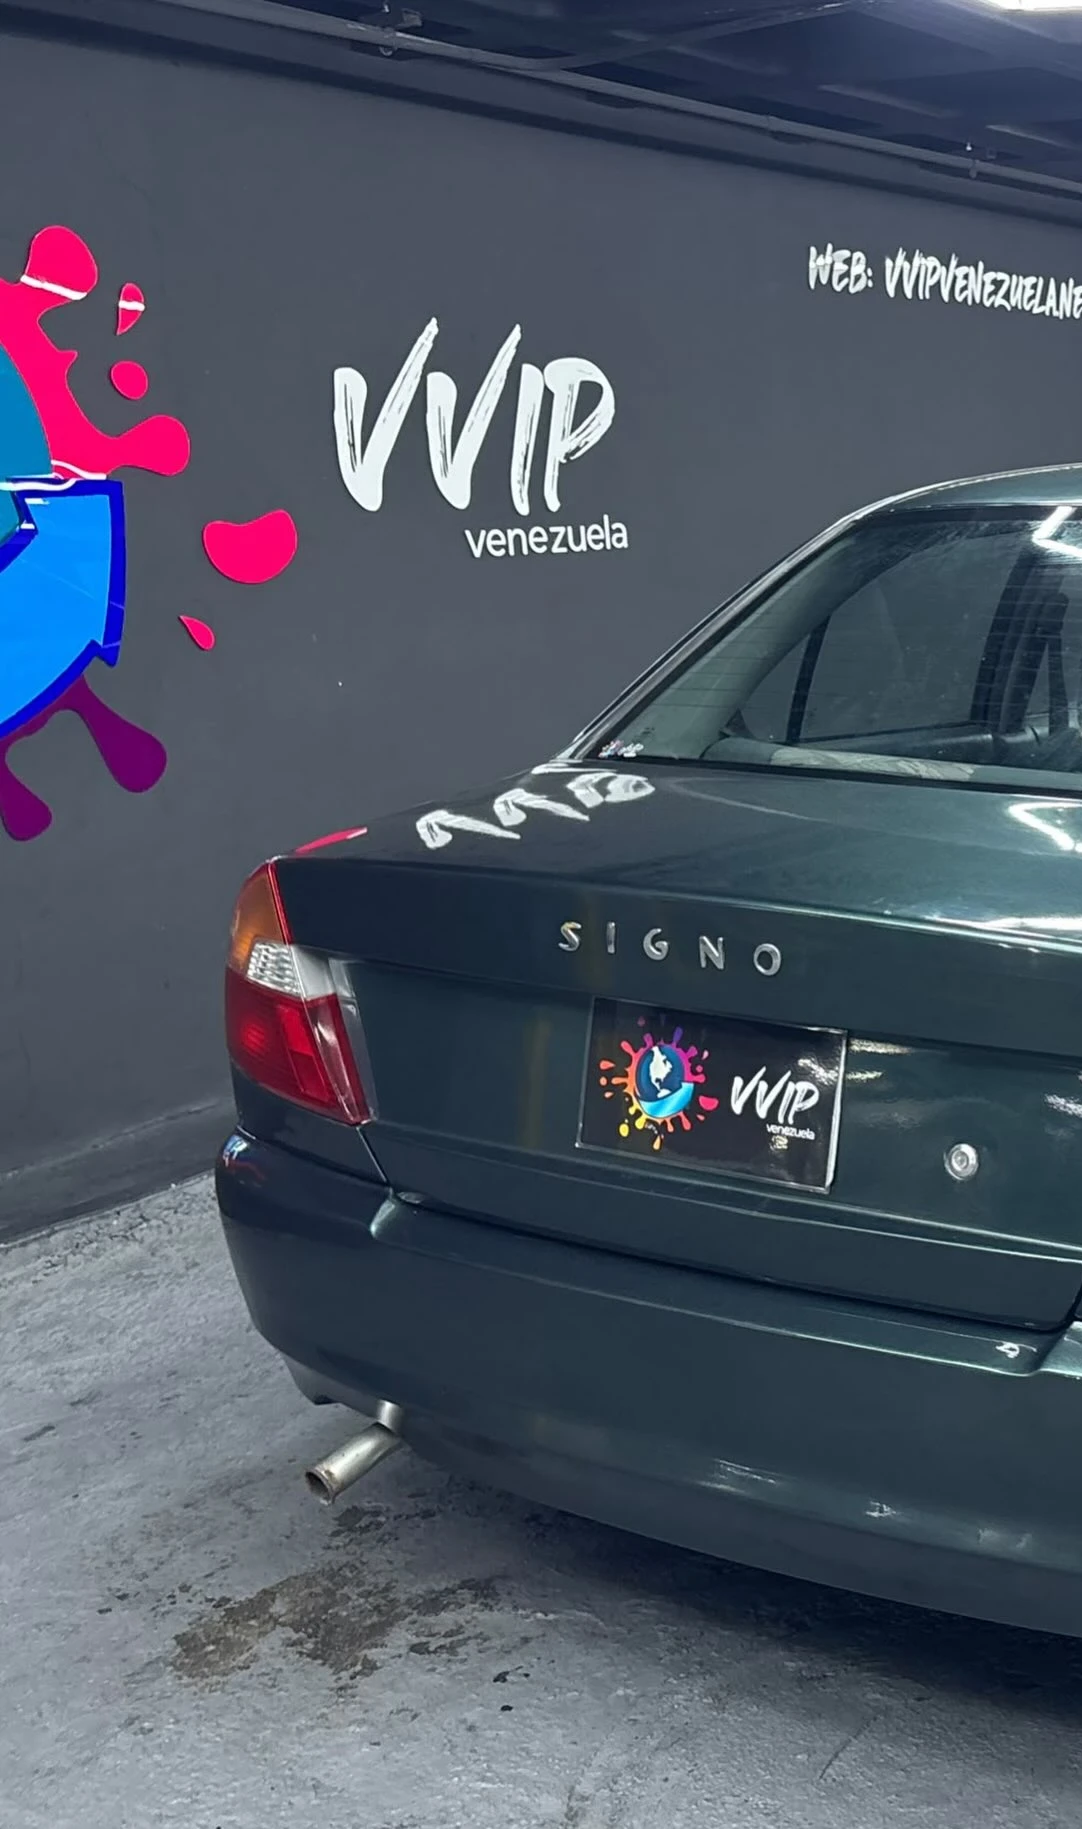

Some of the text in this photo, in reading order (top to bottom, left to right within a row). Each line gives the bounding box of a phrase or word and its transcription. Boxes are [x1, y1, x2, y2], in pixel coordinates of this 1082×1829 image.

[808, 243, 873, 294] WEB:
[333, 316, 616, 515] VVIP
[464, 514, 629, 558] venezuela
[558, 921, 782, 976] SIGNO
[731, 1065, 820, 1125] VVIP
[766, 1123, 816, 1141] venezuela
